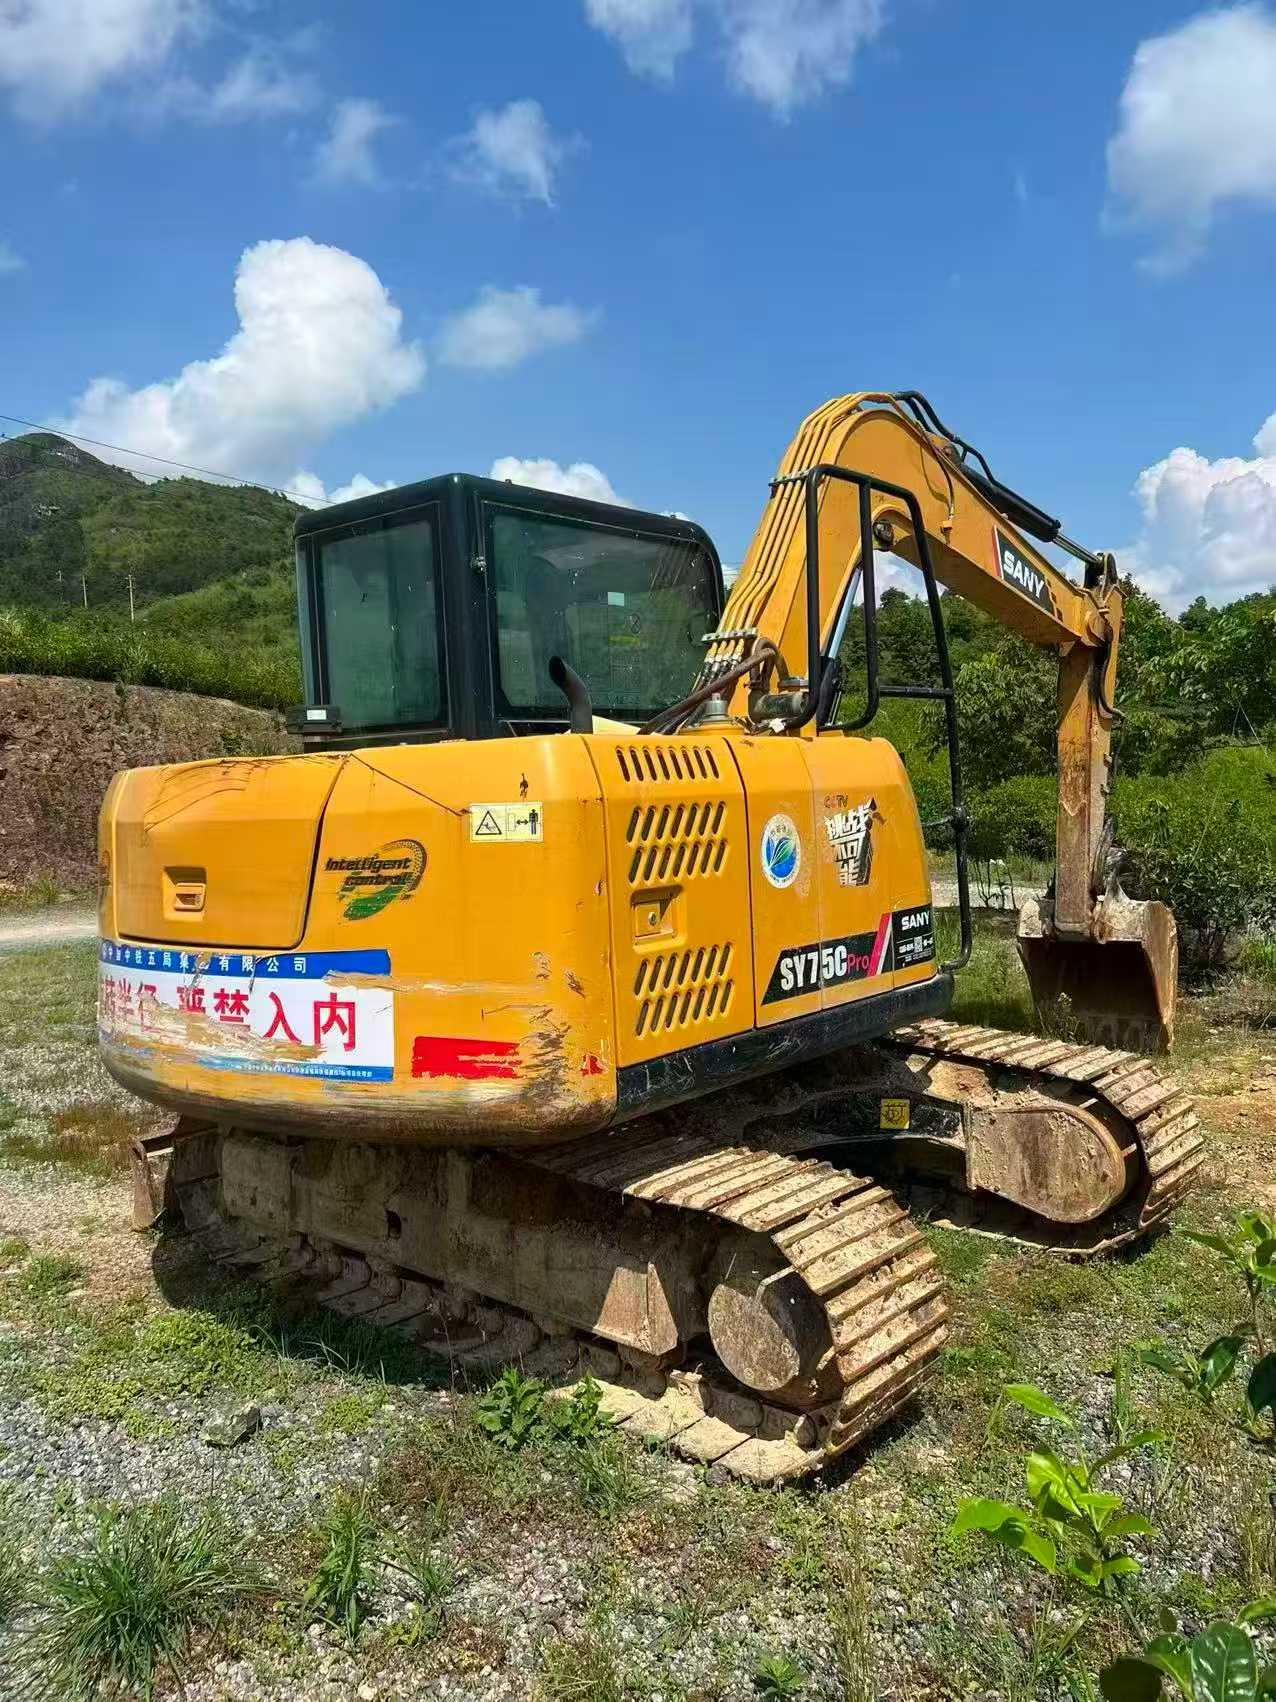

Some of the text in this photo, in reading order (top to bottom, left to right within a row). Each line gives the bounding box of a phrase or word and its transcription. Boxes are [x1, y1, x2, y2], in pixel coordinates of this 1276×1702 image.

[1003, 550, 1044, 598] SANY
[325, 854, 412, 873] Intelligent
[901, 911, 929, 931] SANY
[780, 945, 870, 991] SY75C Pro
